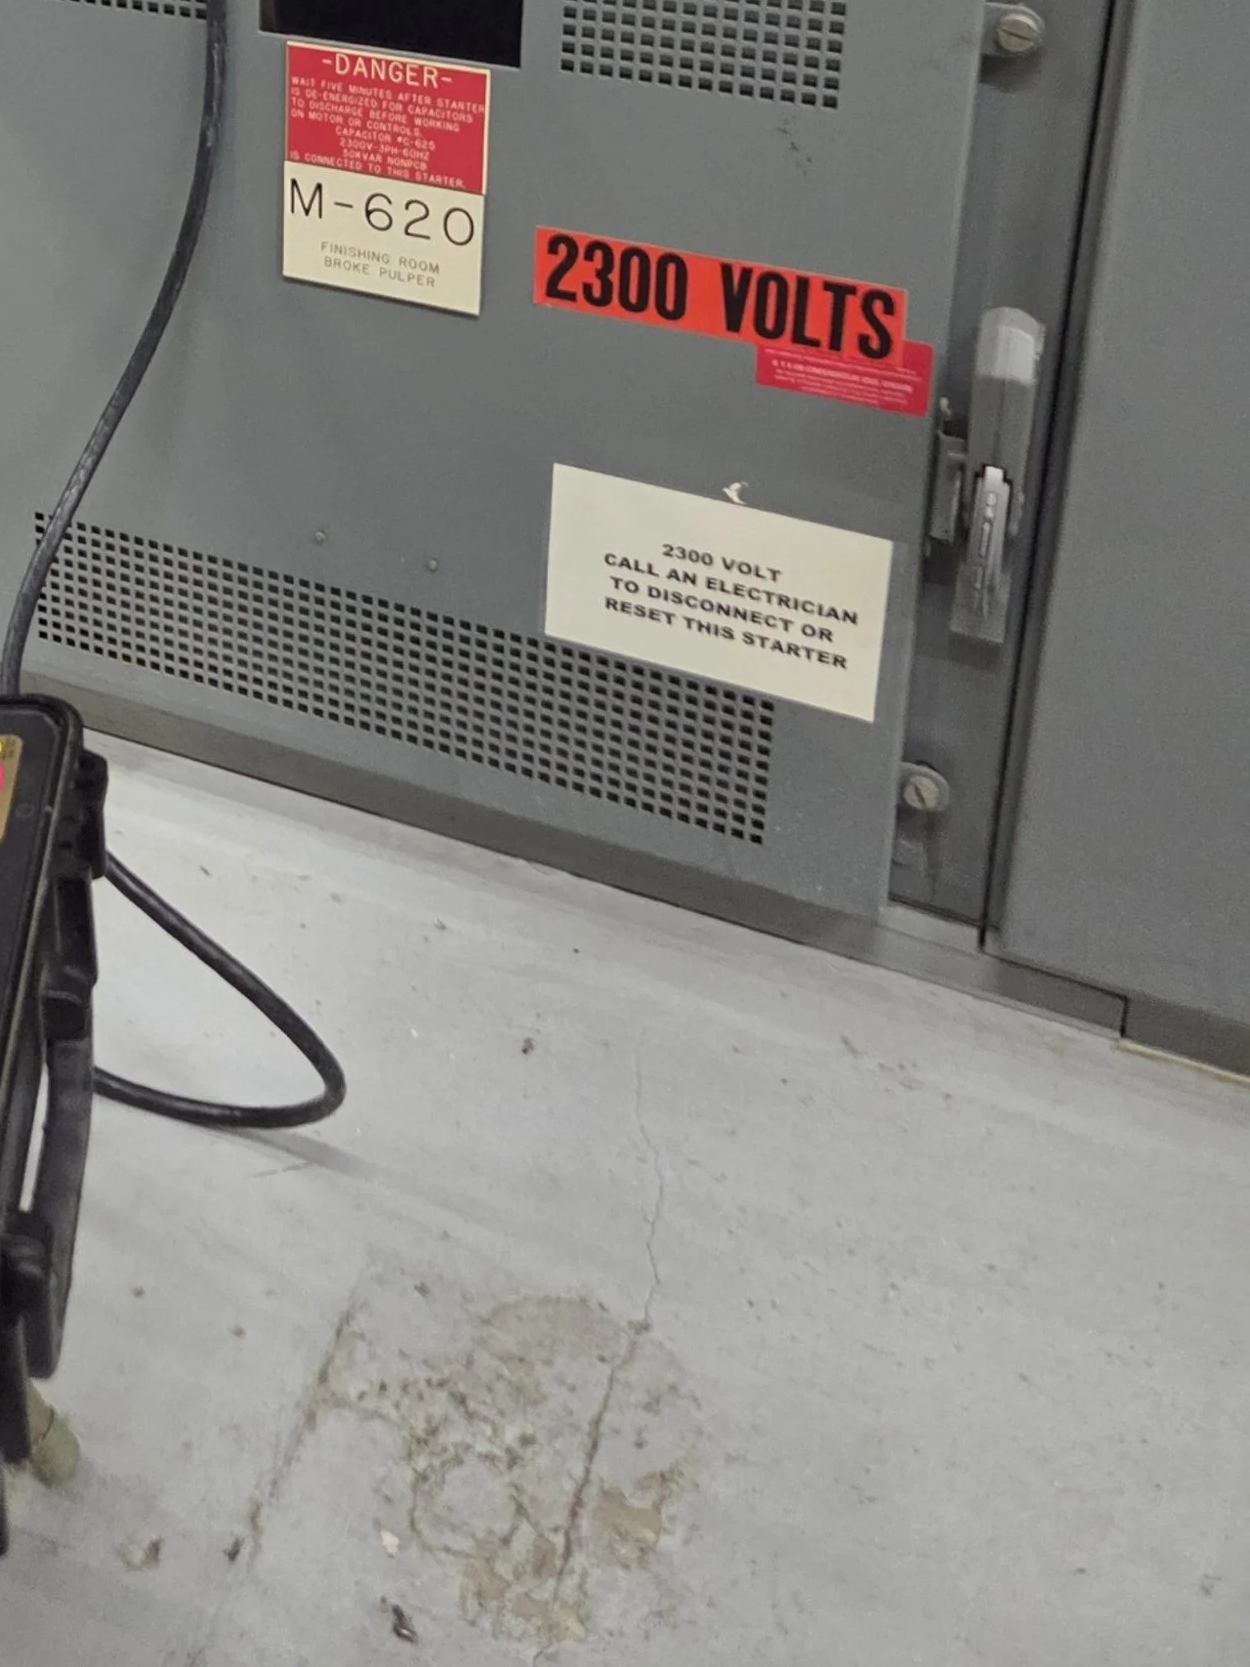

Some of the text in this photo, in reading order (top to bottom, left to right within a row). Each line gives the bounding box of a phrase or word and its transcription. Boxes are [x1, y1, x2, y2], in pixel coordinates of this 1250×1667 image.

[291, 76, 485, 113] WAIT FIVE MINUTES AFTER STARTER
[291, 87, 473, 123] IS DE-ENERGIZED FOR CAPACITORS
[290, 109, 304, 118] ON
[309, 112, 344, 124] MOTOR
[348, 118, 361, 127] OR
[292, 98, 461, 132] TO DISCHARGE BEFORE WORKING
[336, 126, 392, 143] CAPACITOR
[290, 150, 300, 160] IS
[305, 153, 363, 170] CONNECTED
[368, 163, 381, 174] TO
[387, 167, 410, 179] THIS
[387, 156, 427, 171] NONPCB
[290, 178, 475, 247] M-620
[320, 241, 440, 275] FINISHING ROOM
[324, 256, 436, 288] BROKE PULPER
[545, 234, 896, 360] 2300 VOLTS
[662, 543, 783, 583] 2300 VOLT
[604, 552, 859, 625] CALL AN ELECTRICIAN
[610, 576, 835, 643] TO DISCONNECT OR
[604, 596, 849, 670] RESET THIS STARTER
